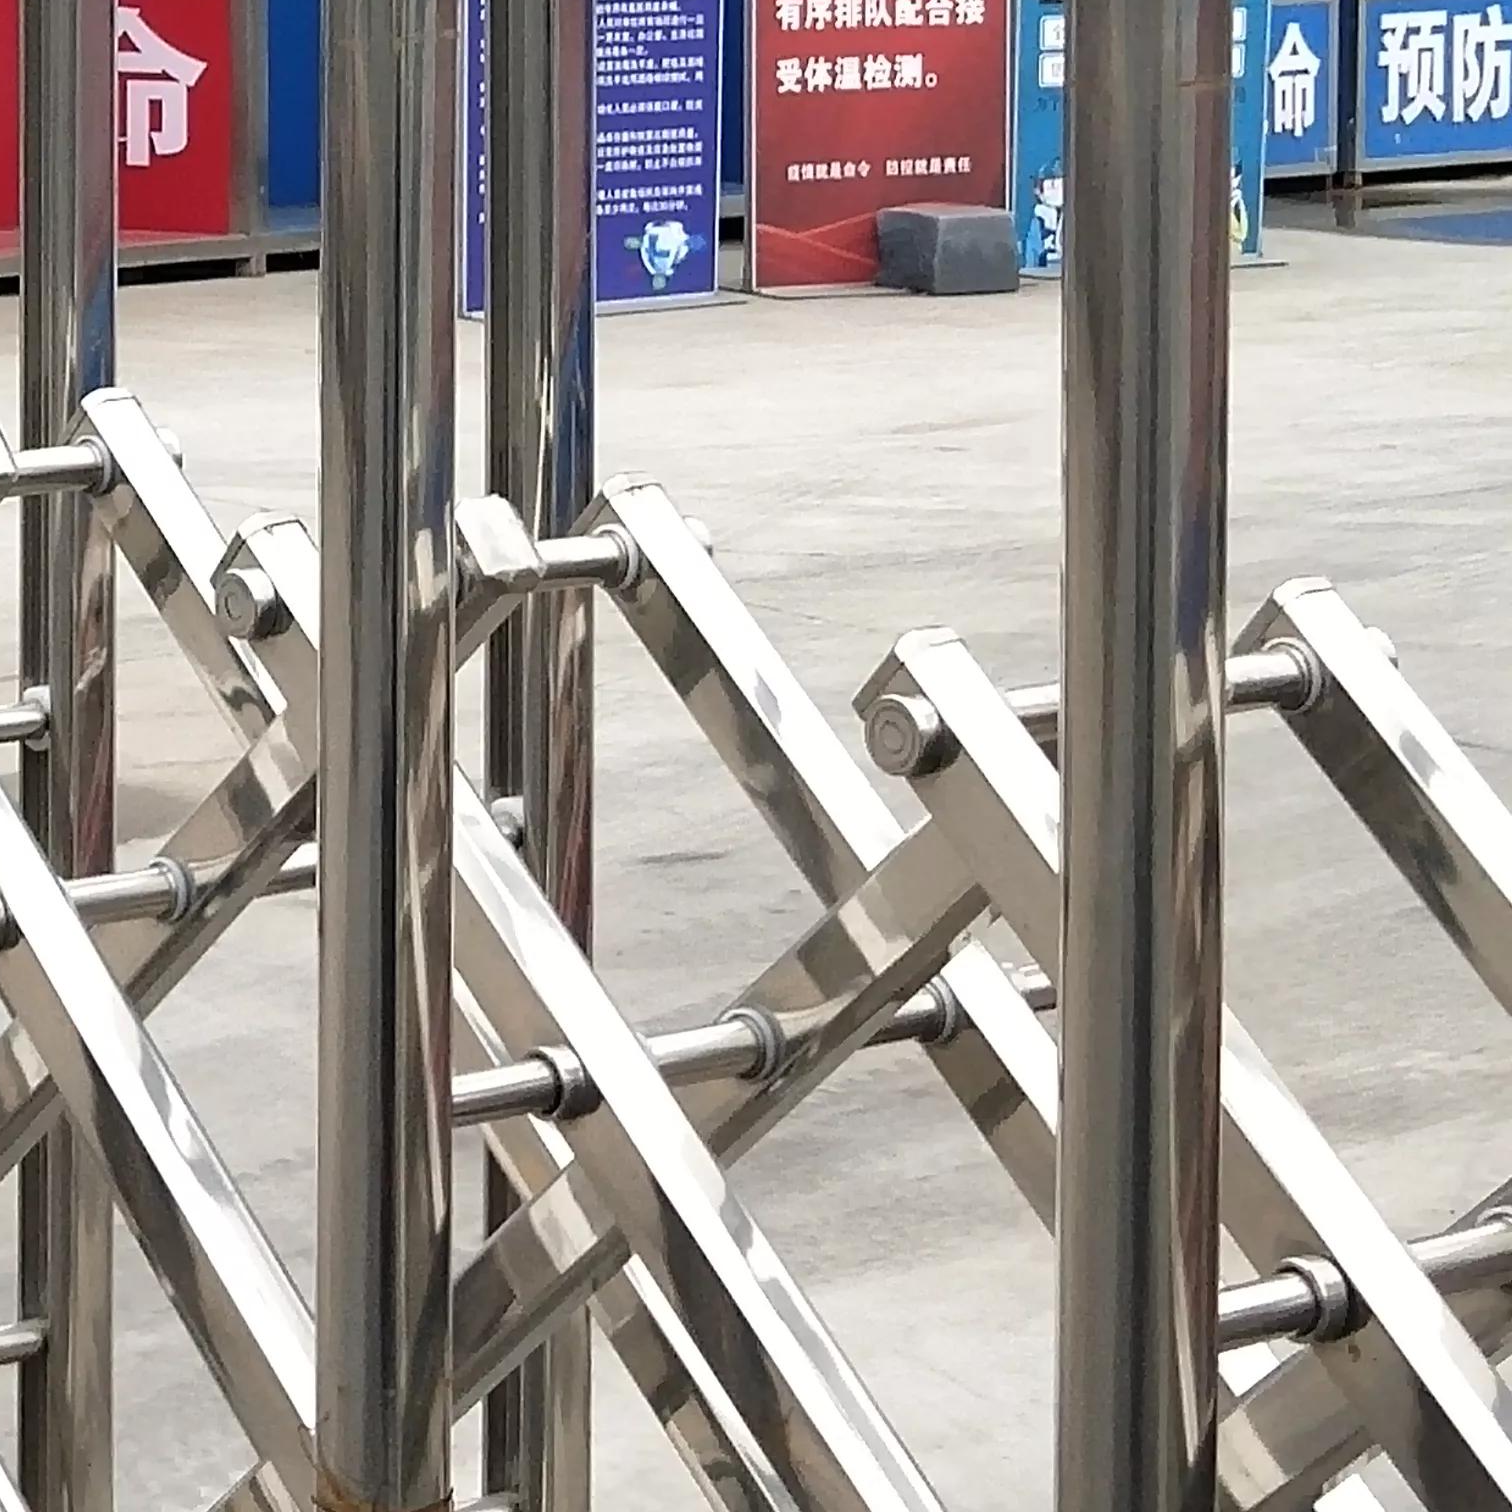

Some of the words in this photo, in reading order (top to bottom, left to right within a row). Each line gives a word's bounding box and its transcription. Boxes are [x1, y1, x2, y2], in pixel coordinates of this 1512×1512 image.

[775, 53, 939, 94] 受体温检测。
[1377, 4, 1512, 126] 预防
